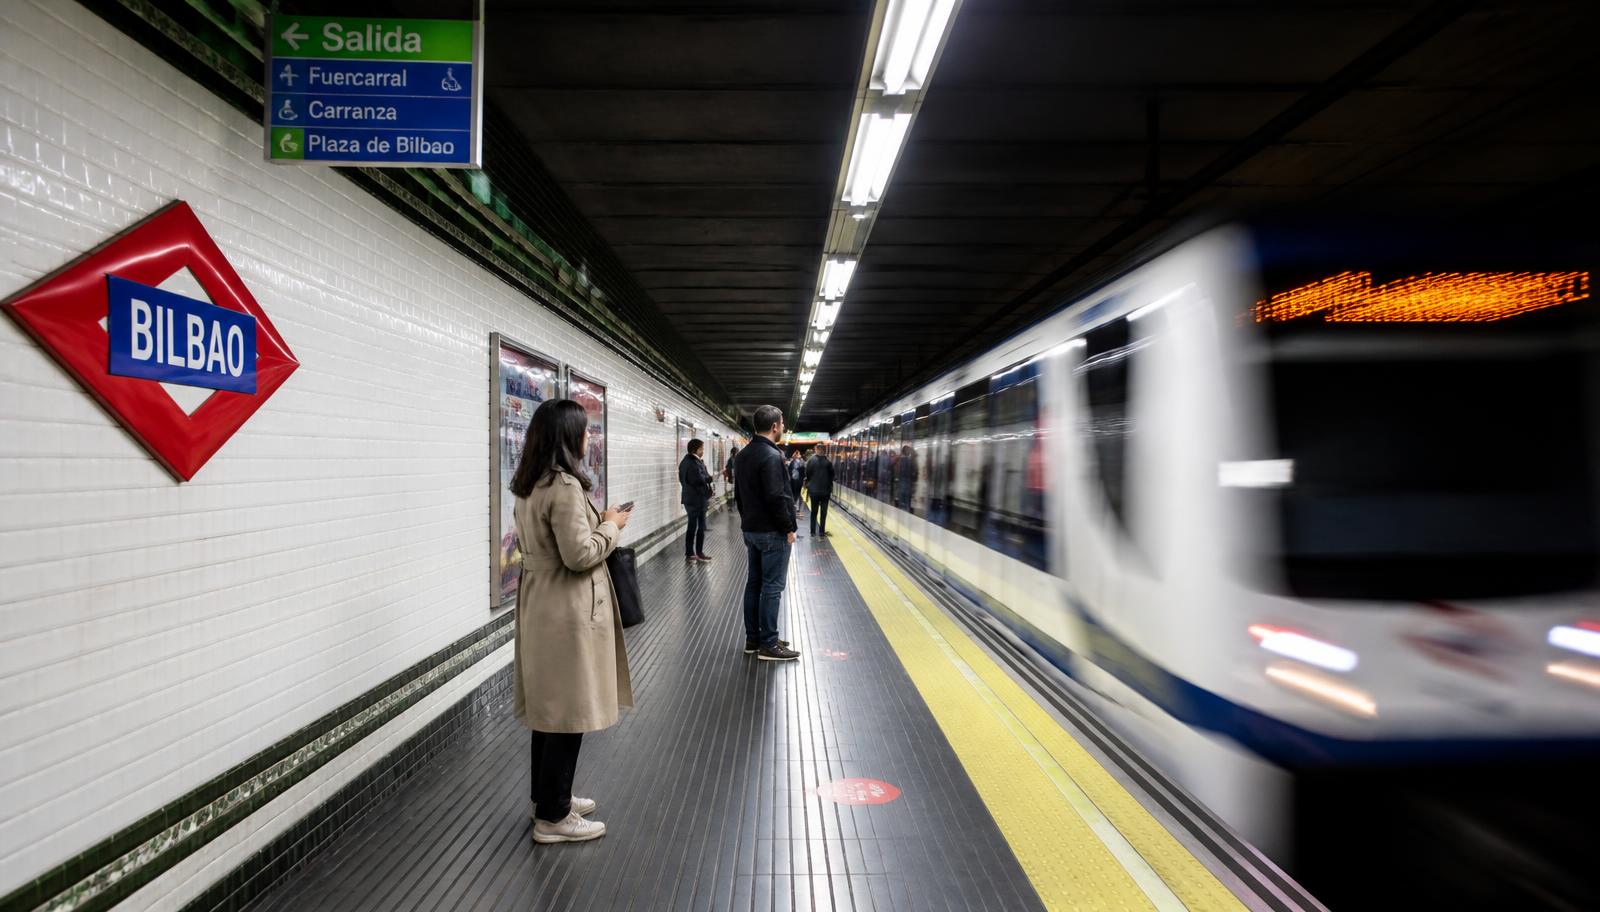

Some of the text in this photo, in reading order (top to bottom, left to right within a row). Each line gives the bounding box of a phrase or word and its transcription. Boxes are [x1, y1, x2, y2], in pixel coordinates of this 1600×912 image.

[322, 22, 422, 53] Salida
[308, 101, 397, 120] Carranza
[308, 135, 455, 154] Plaza de Bilbao
[131, 298, 244, 377] BILBAO
